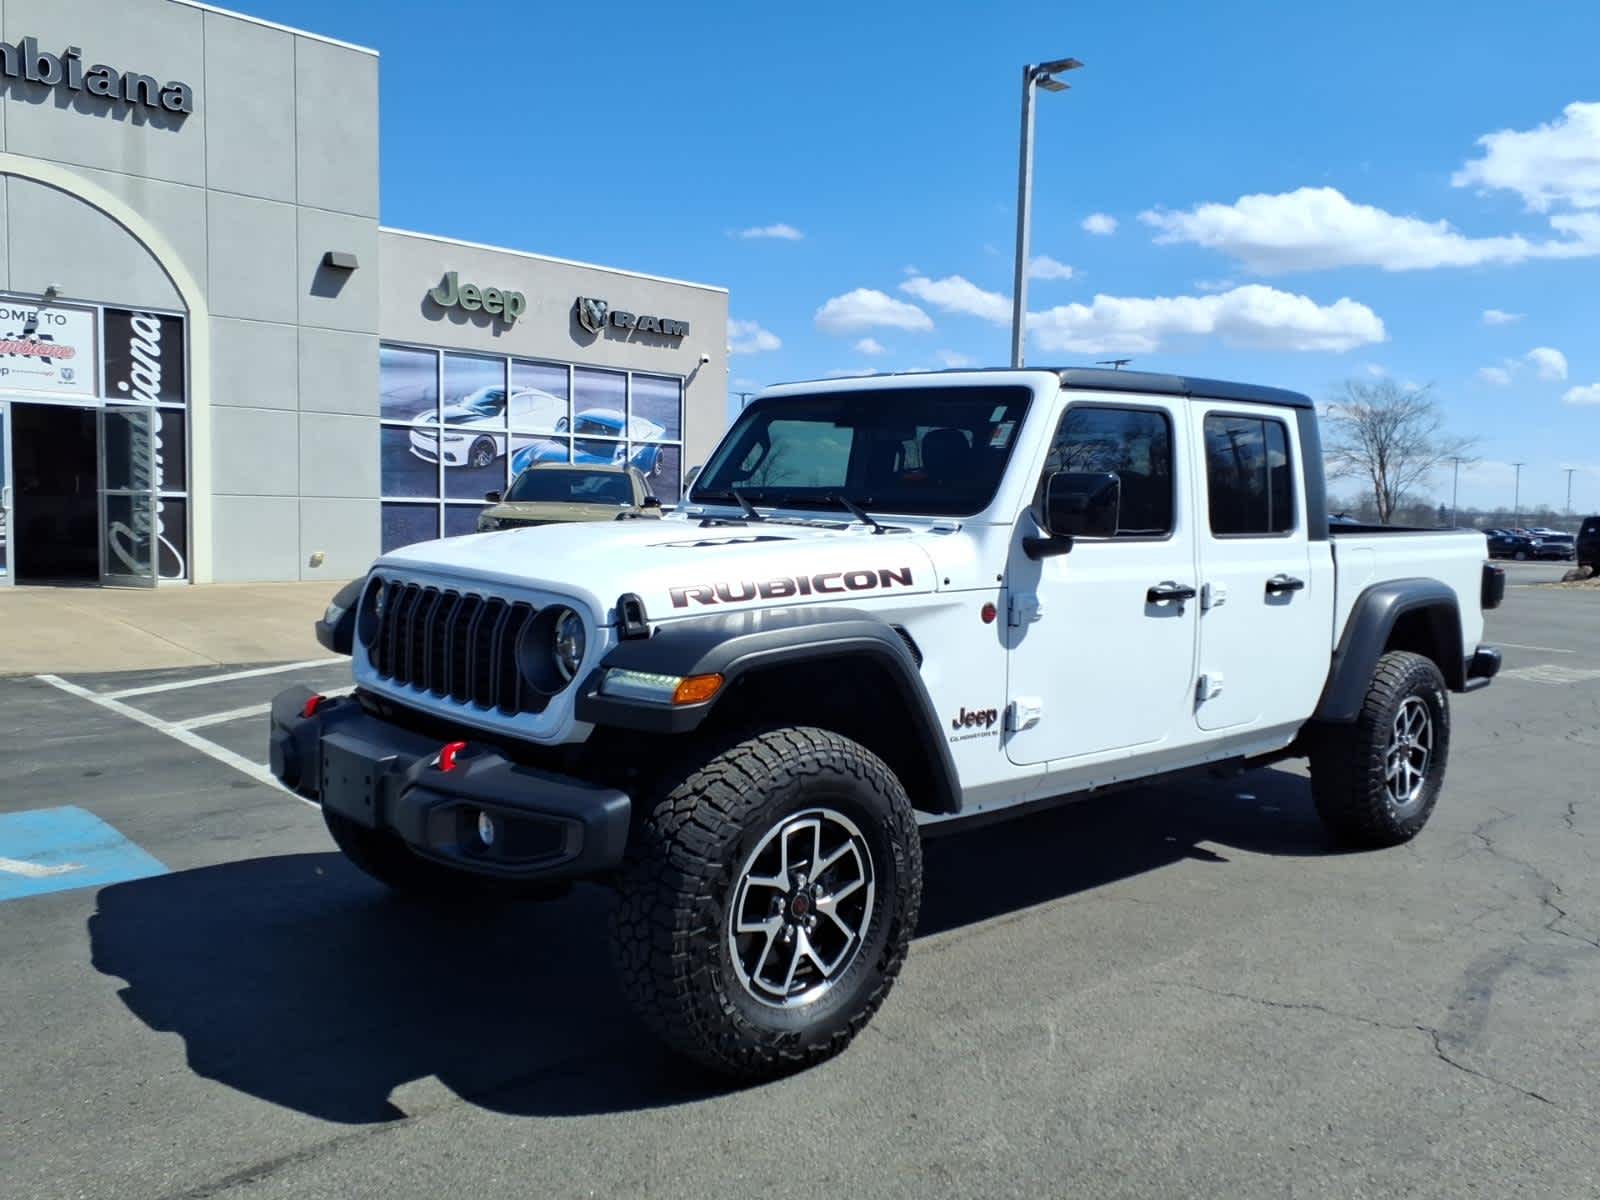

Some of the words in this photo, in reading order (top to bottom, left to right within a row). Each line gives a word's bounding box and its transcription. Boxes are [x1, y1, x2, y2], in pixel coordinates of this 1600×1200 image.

[430, 271, 526, 323] Jeep
[45, 313, 67, 325] TO
[609, 310, 690, 336] RAM
[669, 567, 913, 608] RUBICON
[952, 707, 997, 730] Jeep
